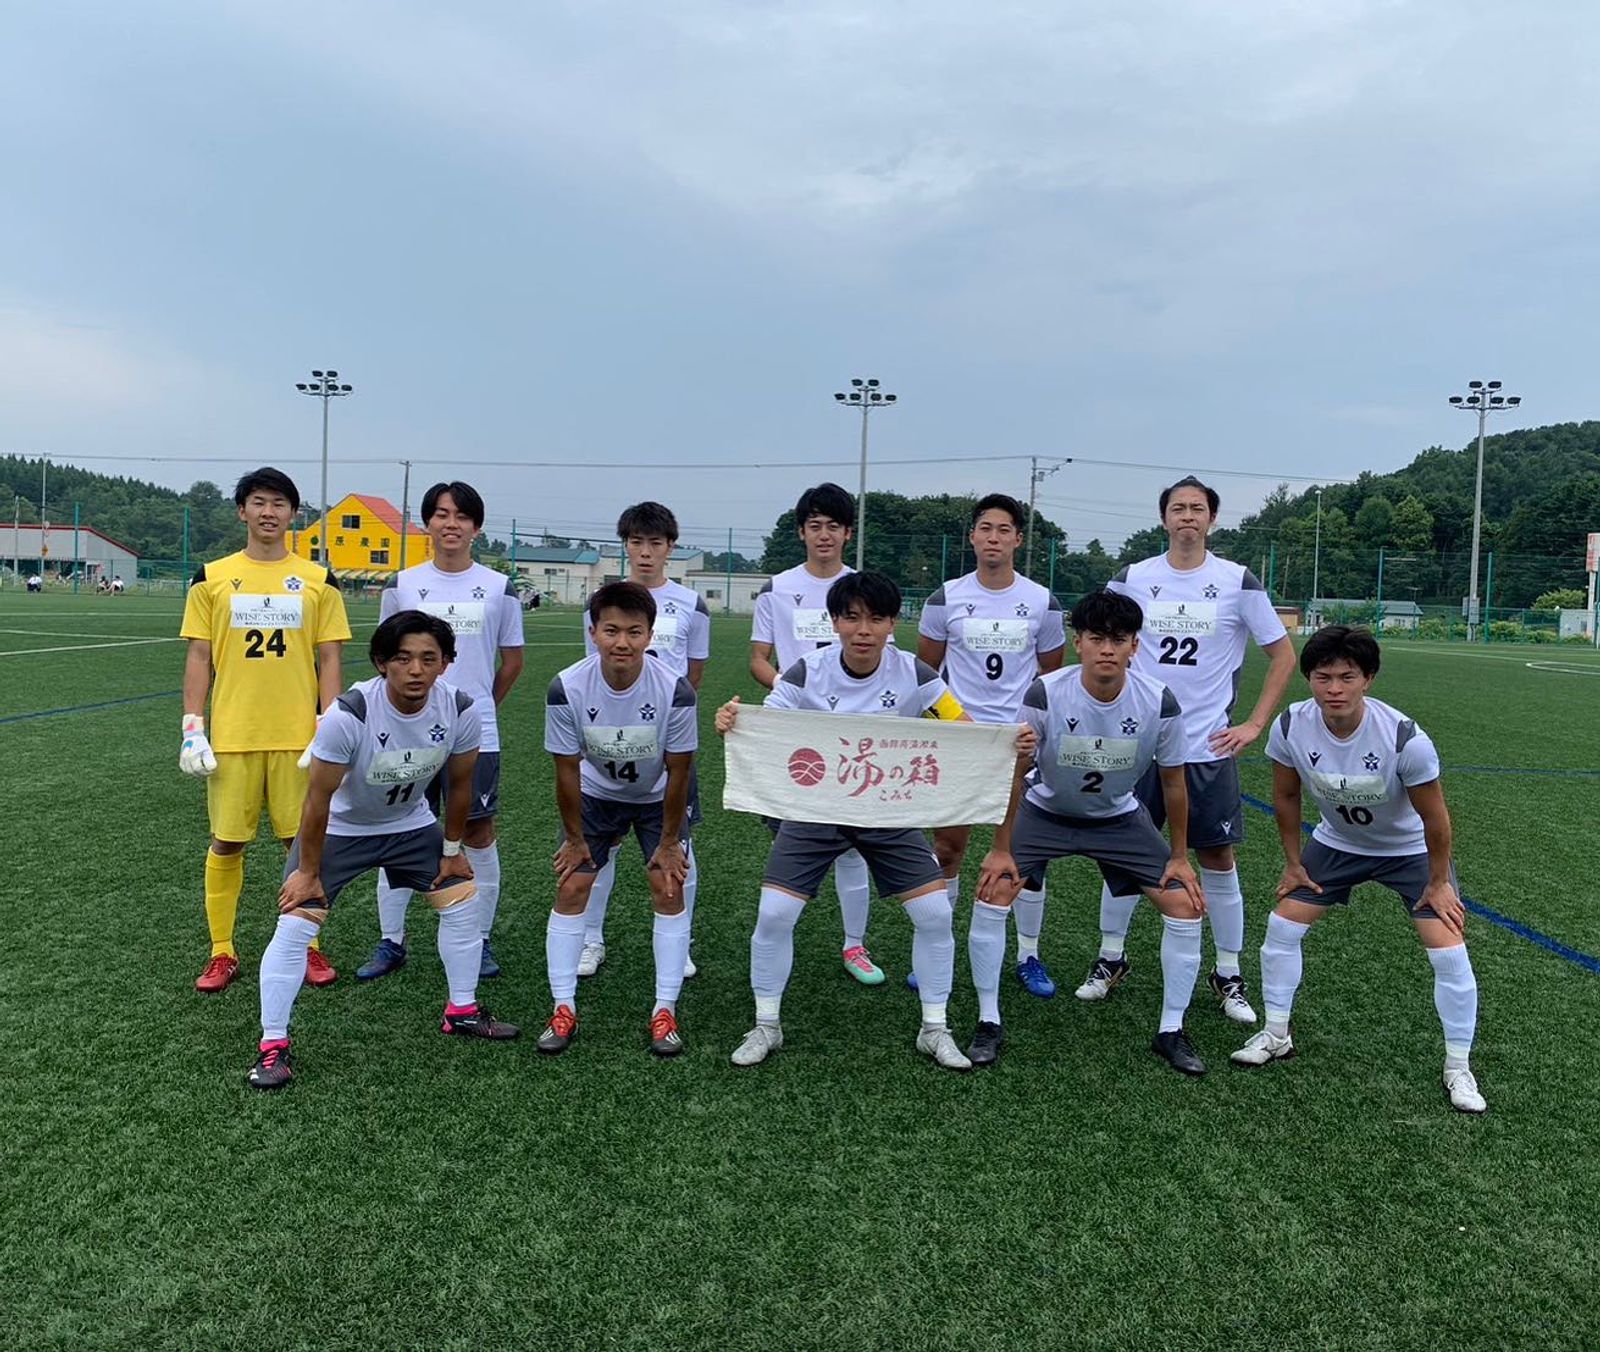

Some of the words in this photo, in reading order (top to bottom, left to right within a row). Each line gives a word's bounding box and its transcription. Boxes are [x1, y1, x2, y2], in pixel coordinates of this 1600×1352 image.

[235, 612, 261, 621] WISE
[263, 612, 297, 621] STORY
[1149, 620, 1174, 629] WISE
[1177, 620, 1212, 630] STORY
[245, 628, 287, 658] 24
[1158, 635, 1199, 667] 22
[985, 652, 1004, 681] 9
[837, 737, 940, 797] 湯の箱
[1062, 753, 1089, 763] WISE
[1093, 754, 1131, 765] STORY
[603, 760, 640, 783] 14
[1081, 771, 1104, 793] 2
[386, 782, 415, 806] 11
[1335, 805, 1373, 826] 10
